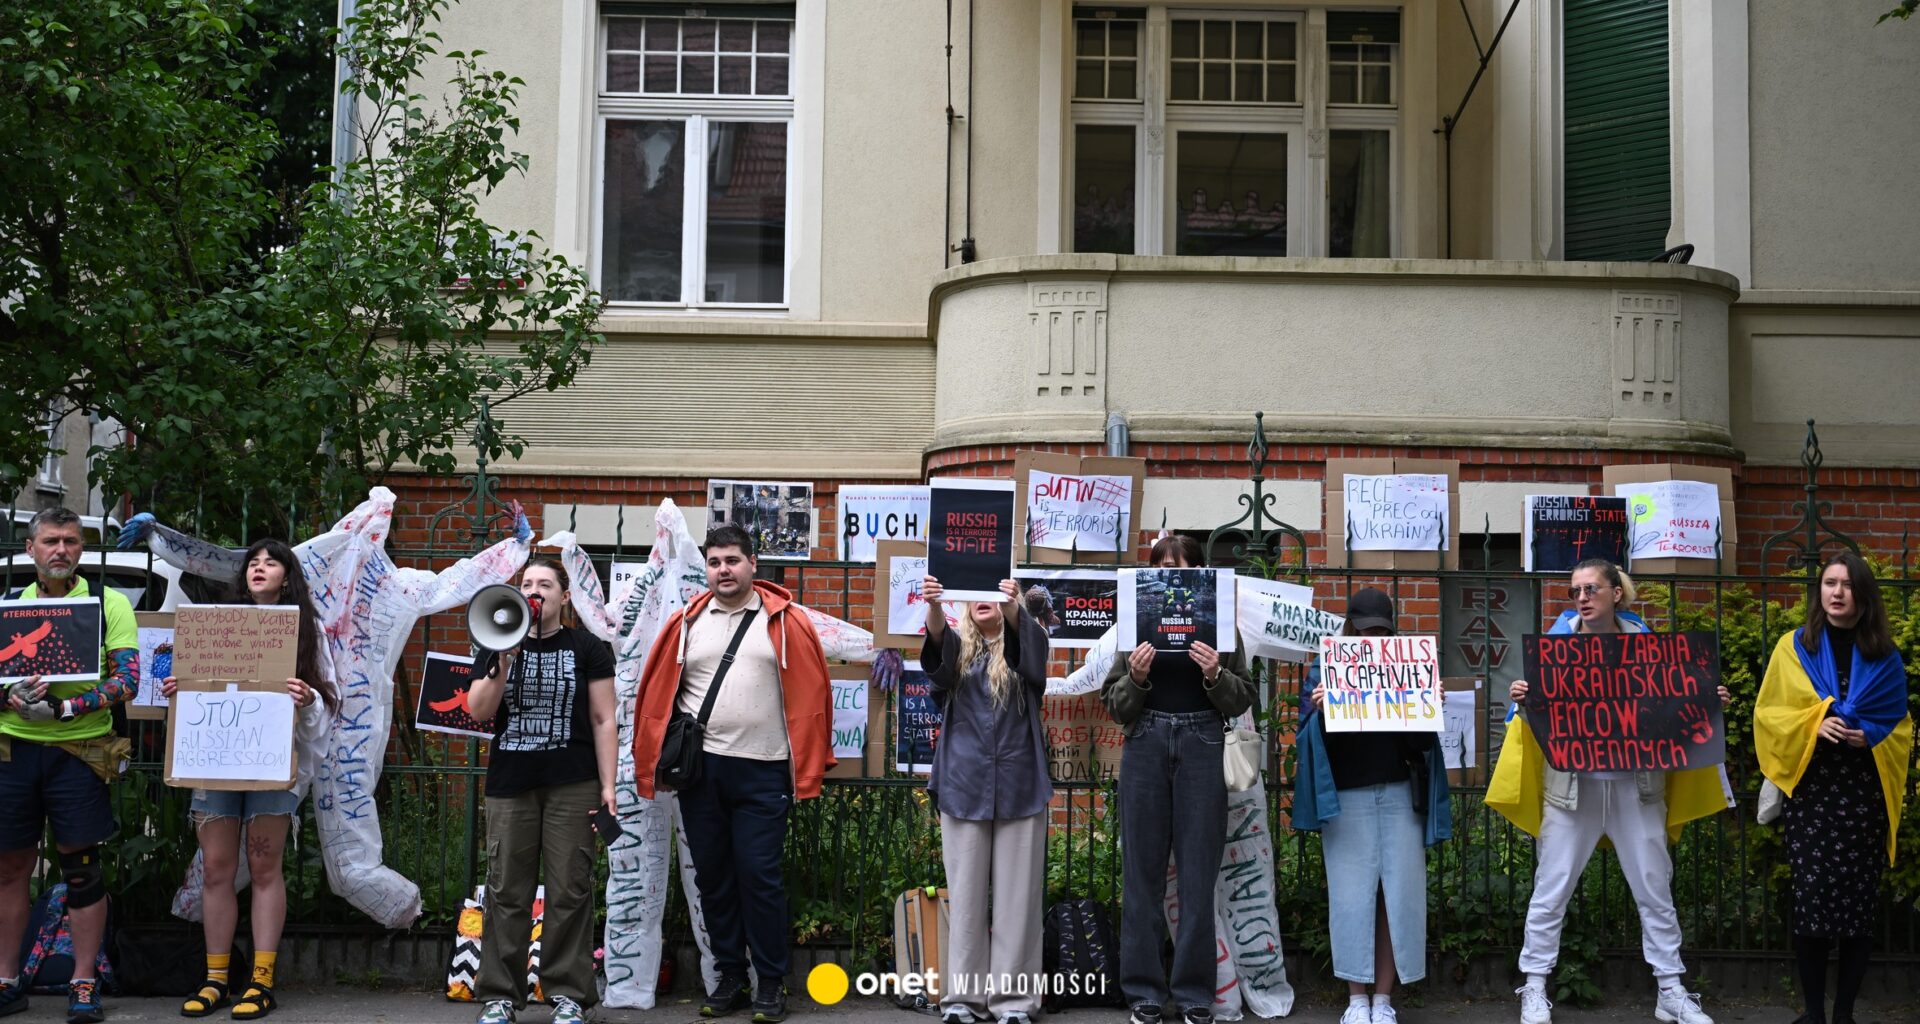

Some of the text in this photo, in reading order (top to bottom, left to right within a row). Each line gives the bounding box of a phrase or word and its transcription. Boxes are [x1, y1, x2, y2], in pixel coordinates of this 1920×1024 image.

[1532, 496, 1596, 508] RUSSIA IS A
[1420, 503, 1438, 520] od
[1532, 509, 1626, 522] TERRORIST STATE
[946, 512, 998, 528] RUSSIA
[1670, 517, 1710, 530] RUSSIA
[960, 528, 998, 536] TERRORIST
[946, 536, 996, 554] STATE
[1066, 597, 1112, 610] РОСІЯ
[3, 608, 72, 618] #TERRORUSSIA
[1066, 609, 1112, 619] КРАЇНА-
[176, 626, 190, 636] to
[196, 625, 235, 638] change
[240, 626, 258, 636] the
[176, 652, 190, 660] to
[192, 664, 243, 678] disappear
[562, 649, 575, 680] SUMY
[525, 669, 556, 678] LUSK
[904, 683, 930, 696] RUSS
[554, 680, 566, 716] KHERSON
[905, 698, 926, 710] IS A
[186, 693, 262, 728] STOP
[520, 719, 552, 734] LVIV
[336, 671, 372, 820] KHARKIV
[176, 746, 286, 766] AGGRESSION
[609, 856, 643, 988] UKRAINE
[1220, 855, 1282, 994] RUSSIAN
